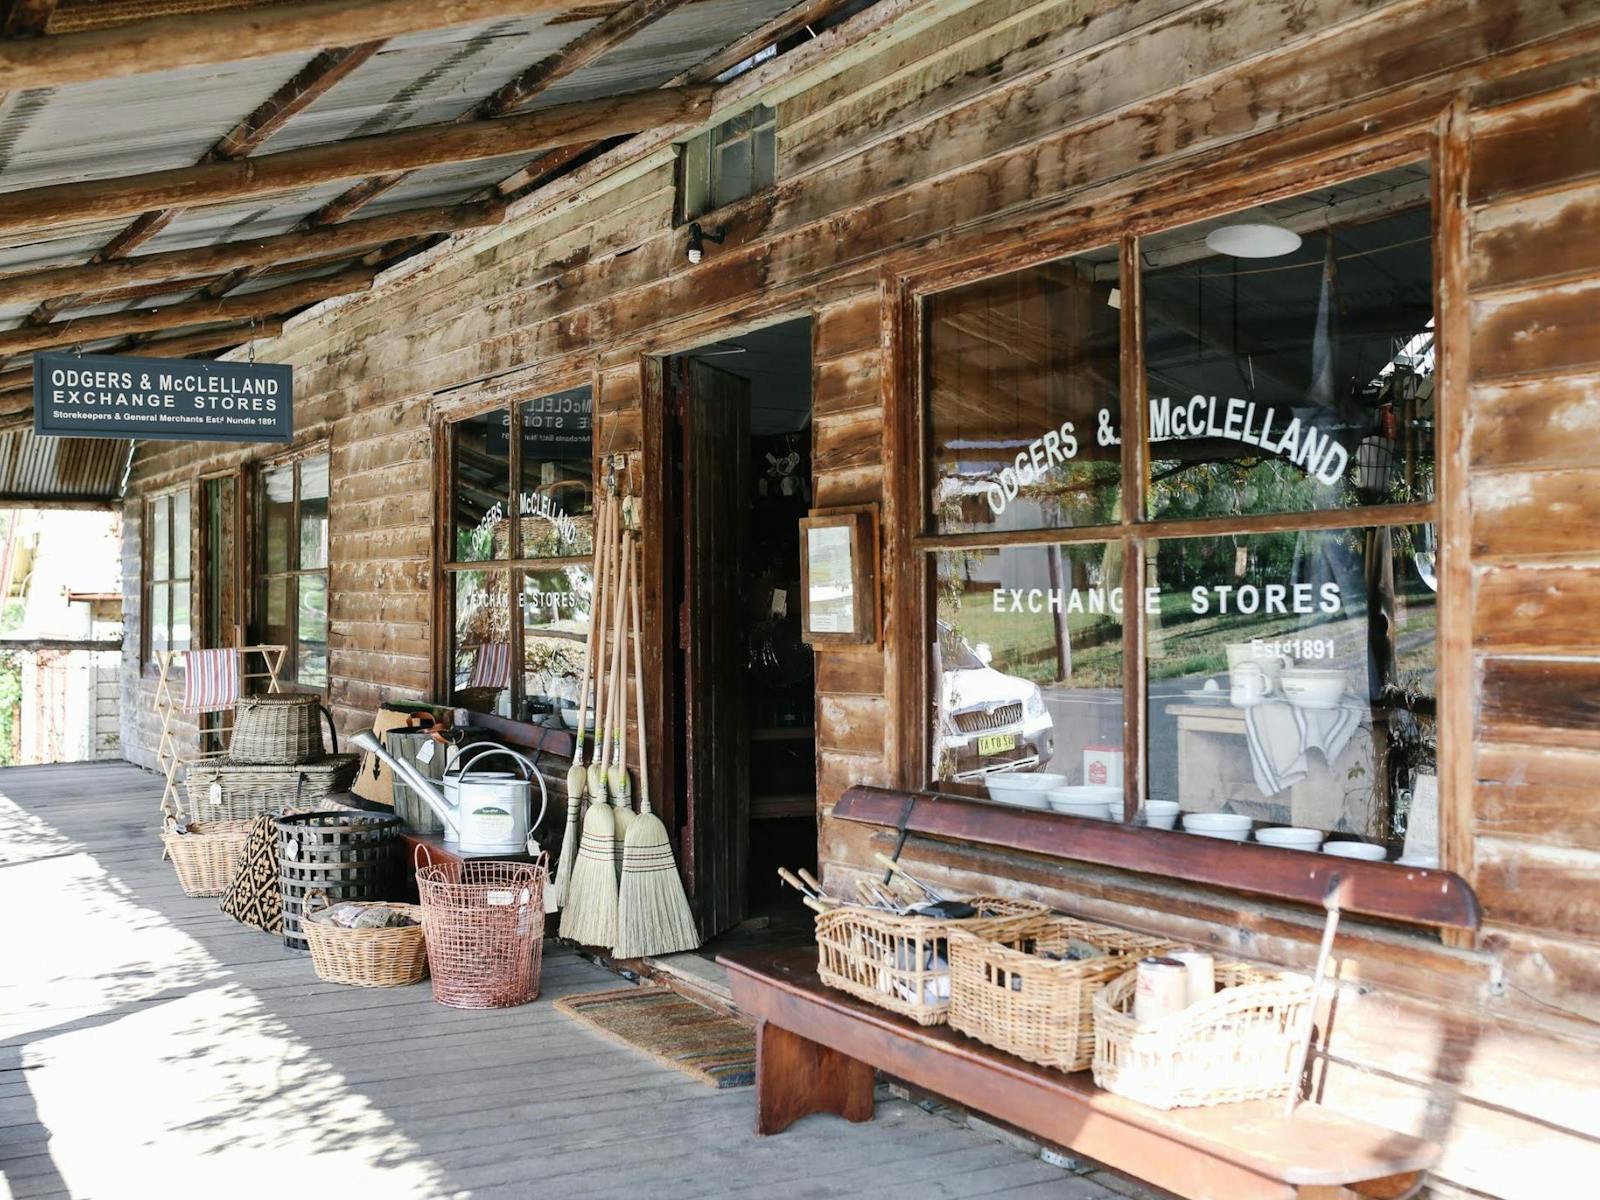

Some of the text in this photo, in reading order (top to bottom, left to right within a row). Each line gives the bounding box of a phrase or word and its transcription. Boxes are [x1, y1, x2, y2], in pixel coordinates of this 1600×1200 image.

[51, 369, 279, 395] ODGERS & McCLELLAND
[53, 390, 277, 411] EXCHANGE STORES
[52, 410, 112, 421] Storekeepers
[114, 412, 121, 420] &
[123, 413, 157, 422] General
[159, 414, 204, 423] Merchants
[257, 417, 276, 425] 1891
[987, 394, 1349, 515] ODGERS & McCLELLAND
[520, 492, 576, 544] McCLELLAND
[532, 591, 575, 608] STORES
[1191, 582, 1341, 614] STORES
[1292, 639, 1335, 659] 1891
